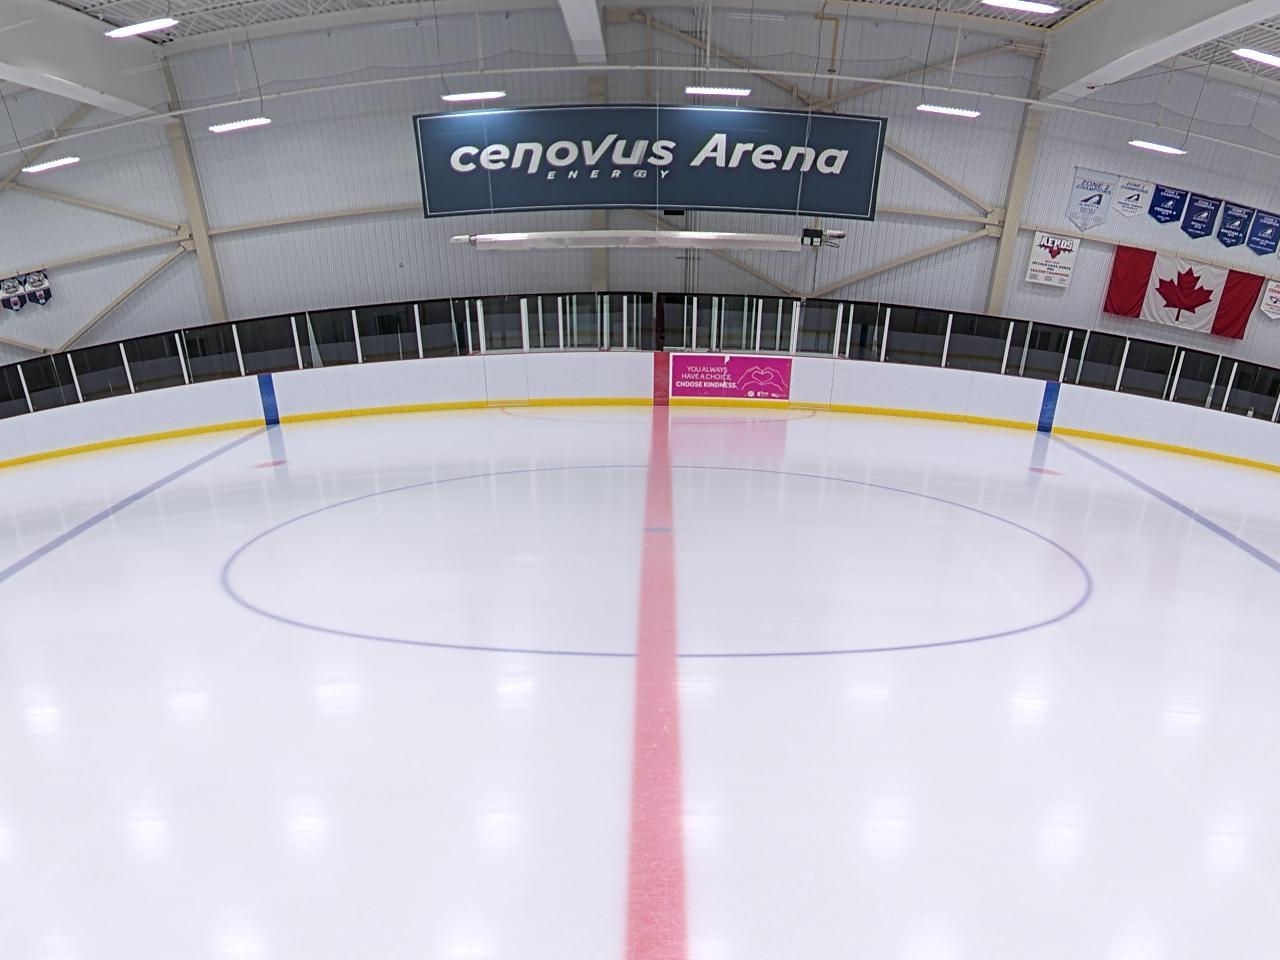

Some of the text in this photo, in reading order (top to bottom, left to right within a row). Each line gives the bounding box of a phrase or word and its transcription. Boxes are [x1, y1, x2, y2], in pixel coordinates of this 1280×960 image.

[450, 133, 849, 174] cenovus Arena
[547, 169, 670, 180] ENERGY
[675, 380, 738, 389] CHOOSE KINDNESS.
